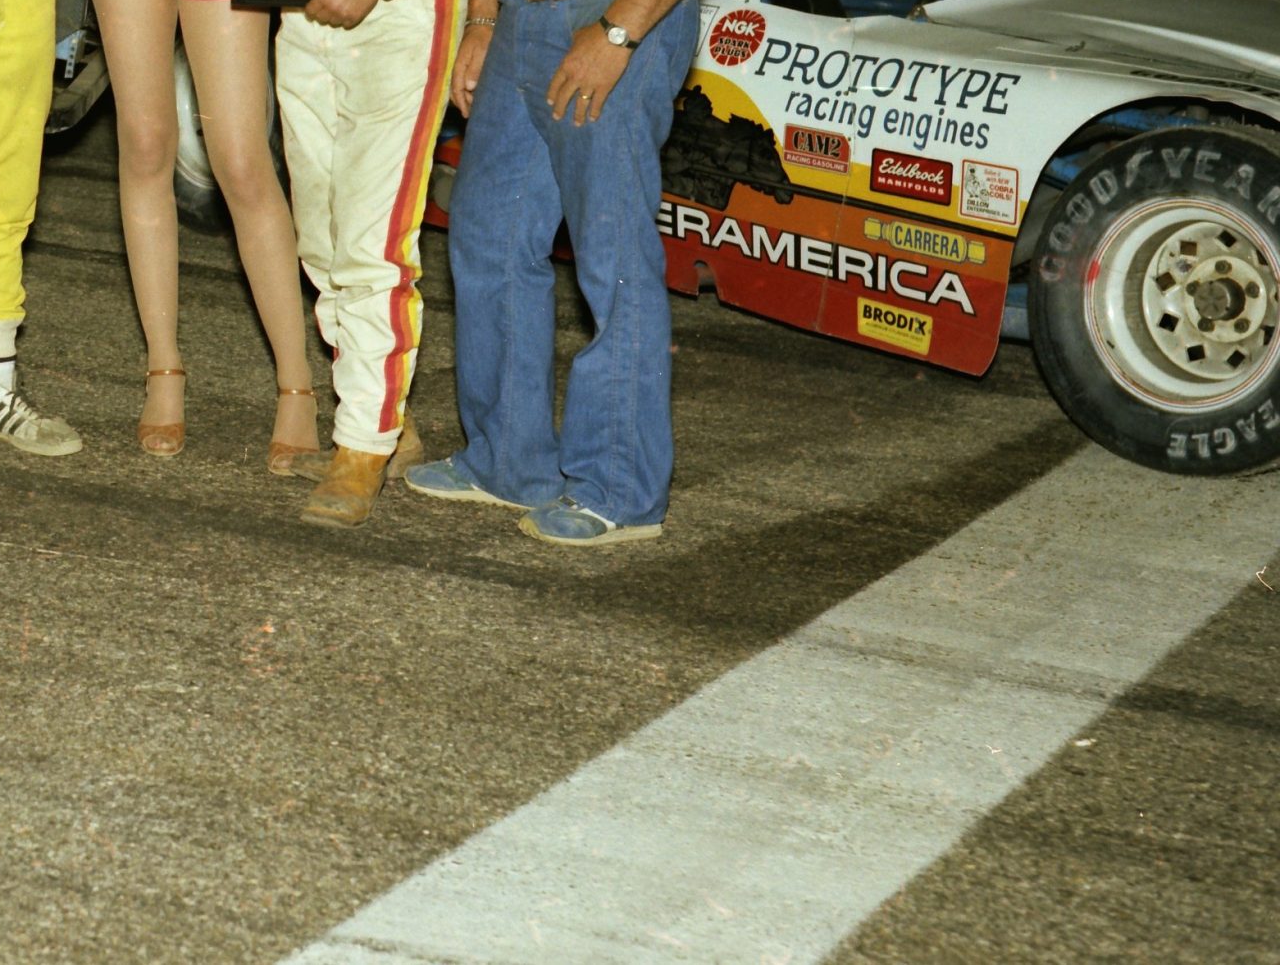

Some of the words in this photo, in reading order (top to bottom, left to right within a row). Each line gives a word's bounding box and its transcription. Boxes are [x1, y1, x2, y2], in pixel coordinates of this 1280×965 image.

[722, 19, 759, 37] NGK
[715, 46, 747, 58] PLUGS
[719, 37, 750, 48] SPARK
[754, 38, 1021, 115] PROTOTYPE
[785, 90, 876, 138] racing
[883, 107, 990, 150] engines
[792, 130, 842, 159] CAM2
[786, 153, 811, 166] RACING
[811, 158, 846, 172] GASOLINE
[878, 157, 945, 185] Edelbrock
[877, 176, 945, 196] MANIFOLDS
[894, 225, 960, 258] CARRERA
[863, 304, 927, 336] BRODIX
[1166, 398, 1280, 458] EAGLE
